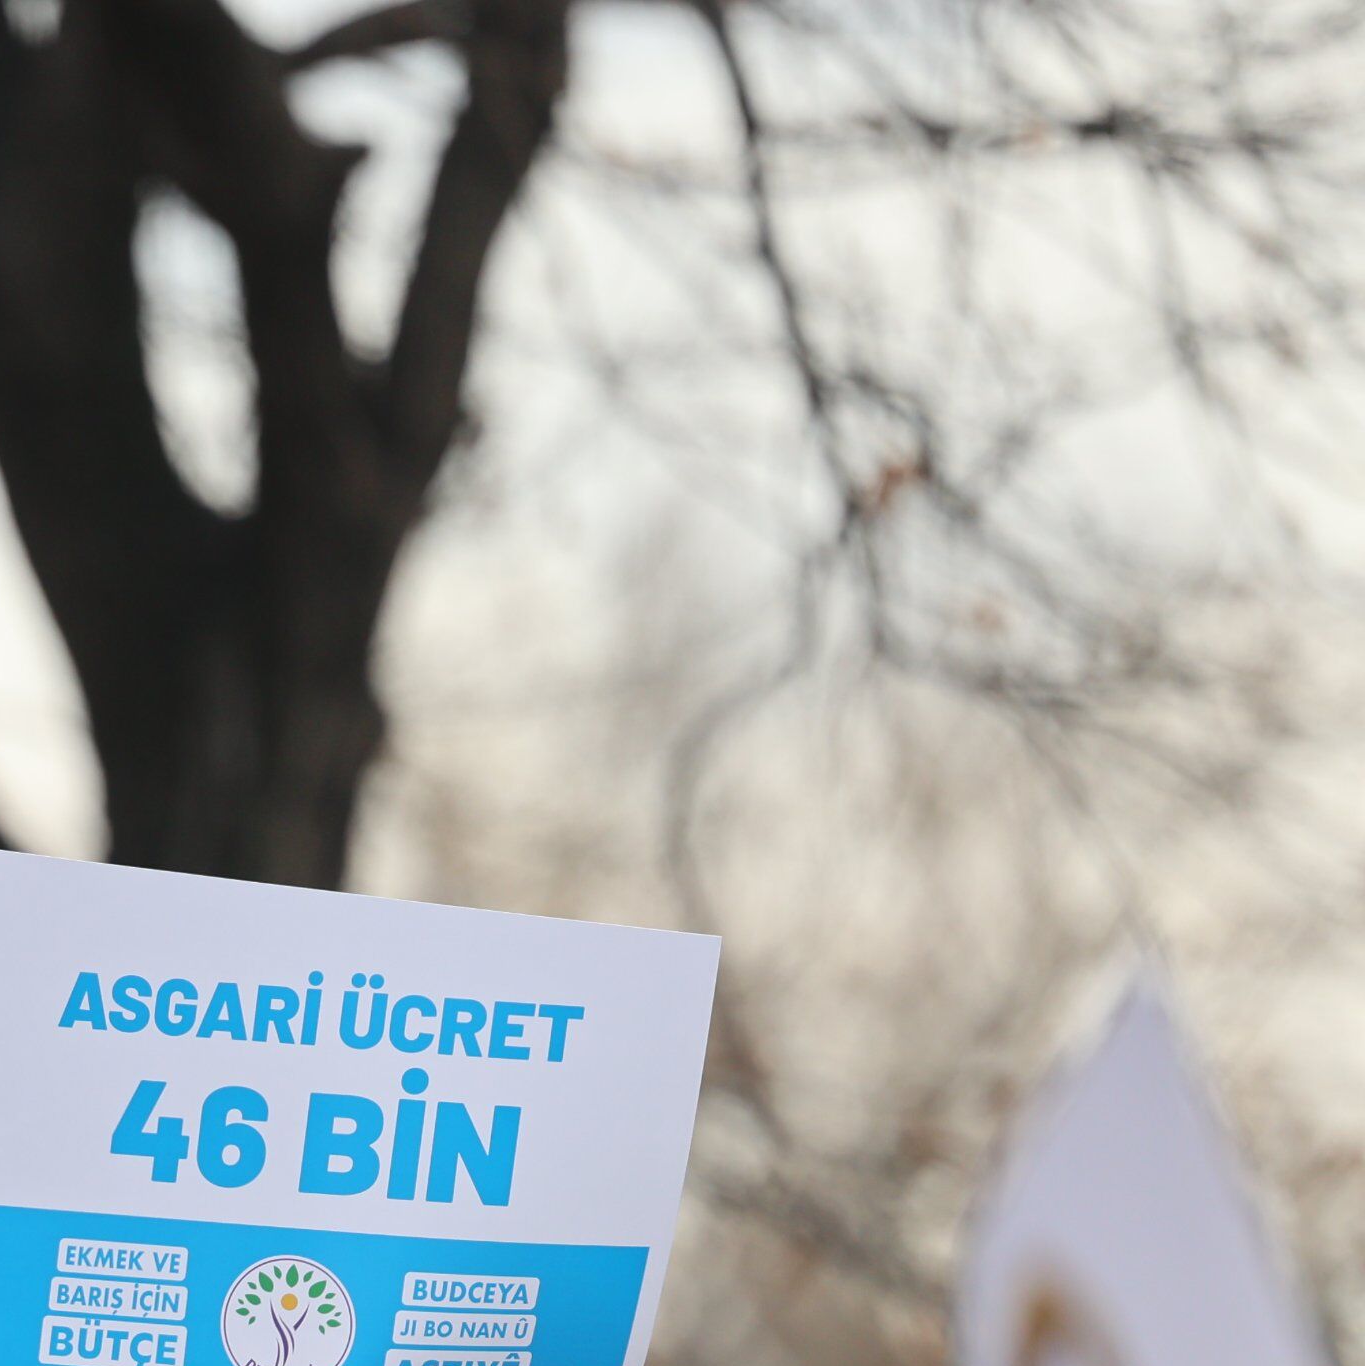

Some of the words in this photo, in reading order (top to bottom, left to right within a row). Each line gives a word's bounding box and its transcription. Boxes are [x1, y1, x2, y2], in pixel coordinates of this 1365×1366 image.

[57, 969, 324, 1046] ASGARİ
[338, 971, 585, 1063] ÜCRET
[109, 1078, 270, 1189] 46
[297, 1067, 522, 1207] BİN
[64, 1244, 145, 1272] EKMEK
[152, 1251, 182, 1275] VE
[55, 1283, 124, 1316] BARIŞ
[131, 1282, 181, 1319] İÇİN
[412, 1278, 530, 1305] BUDCEYA
[399, 1318, 417, 1338] JI
[423, 1319, 453, 1338] BO
[459, 1321, 509, 1339] NAN
[513, 1317, 529, 1340] Û
